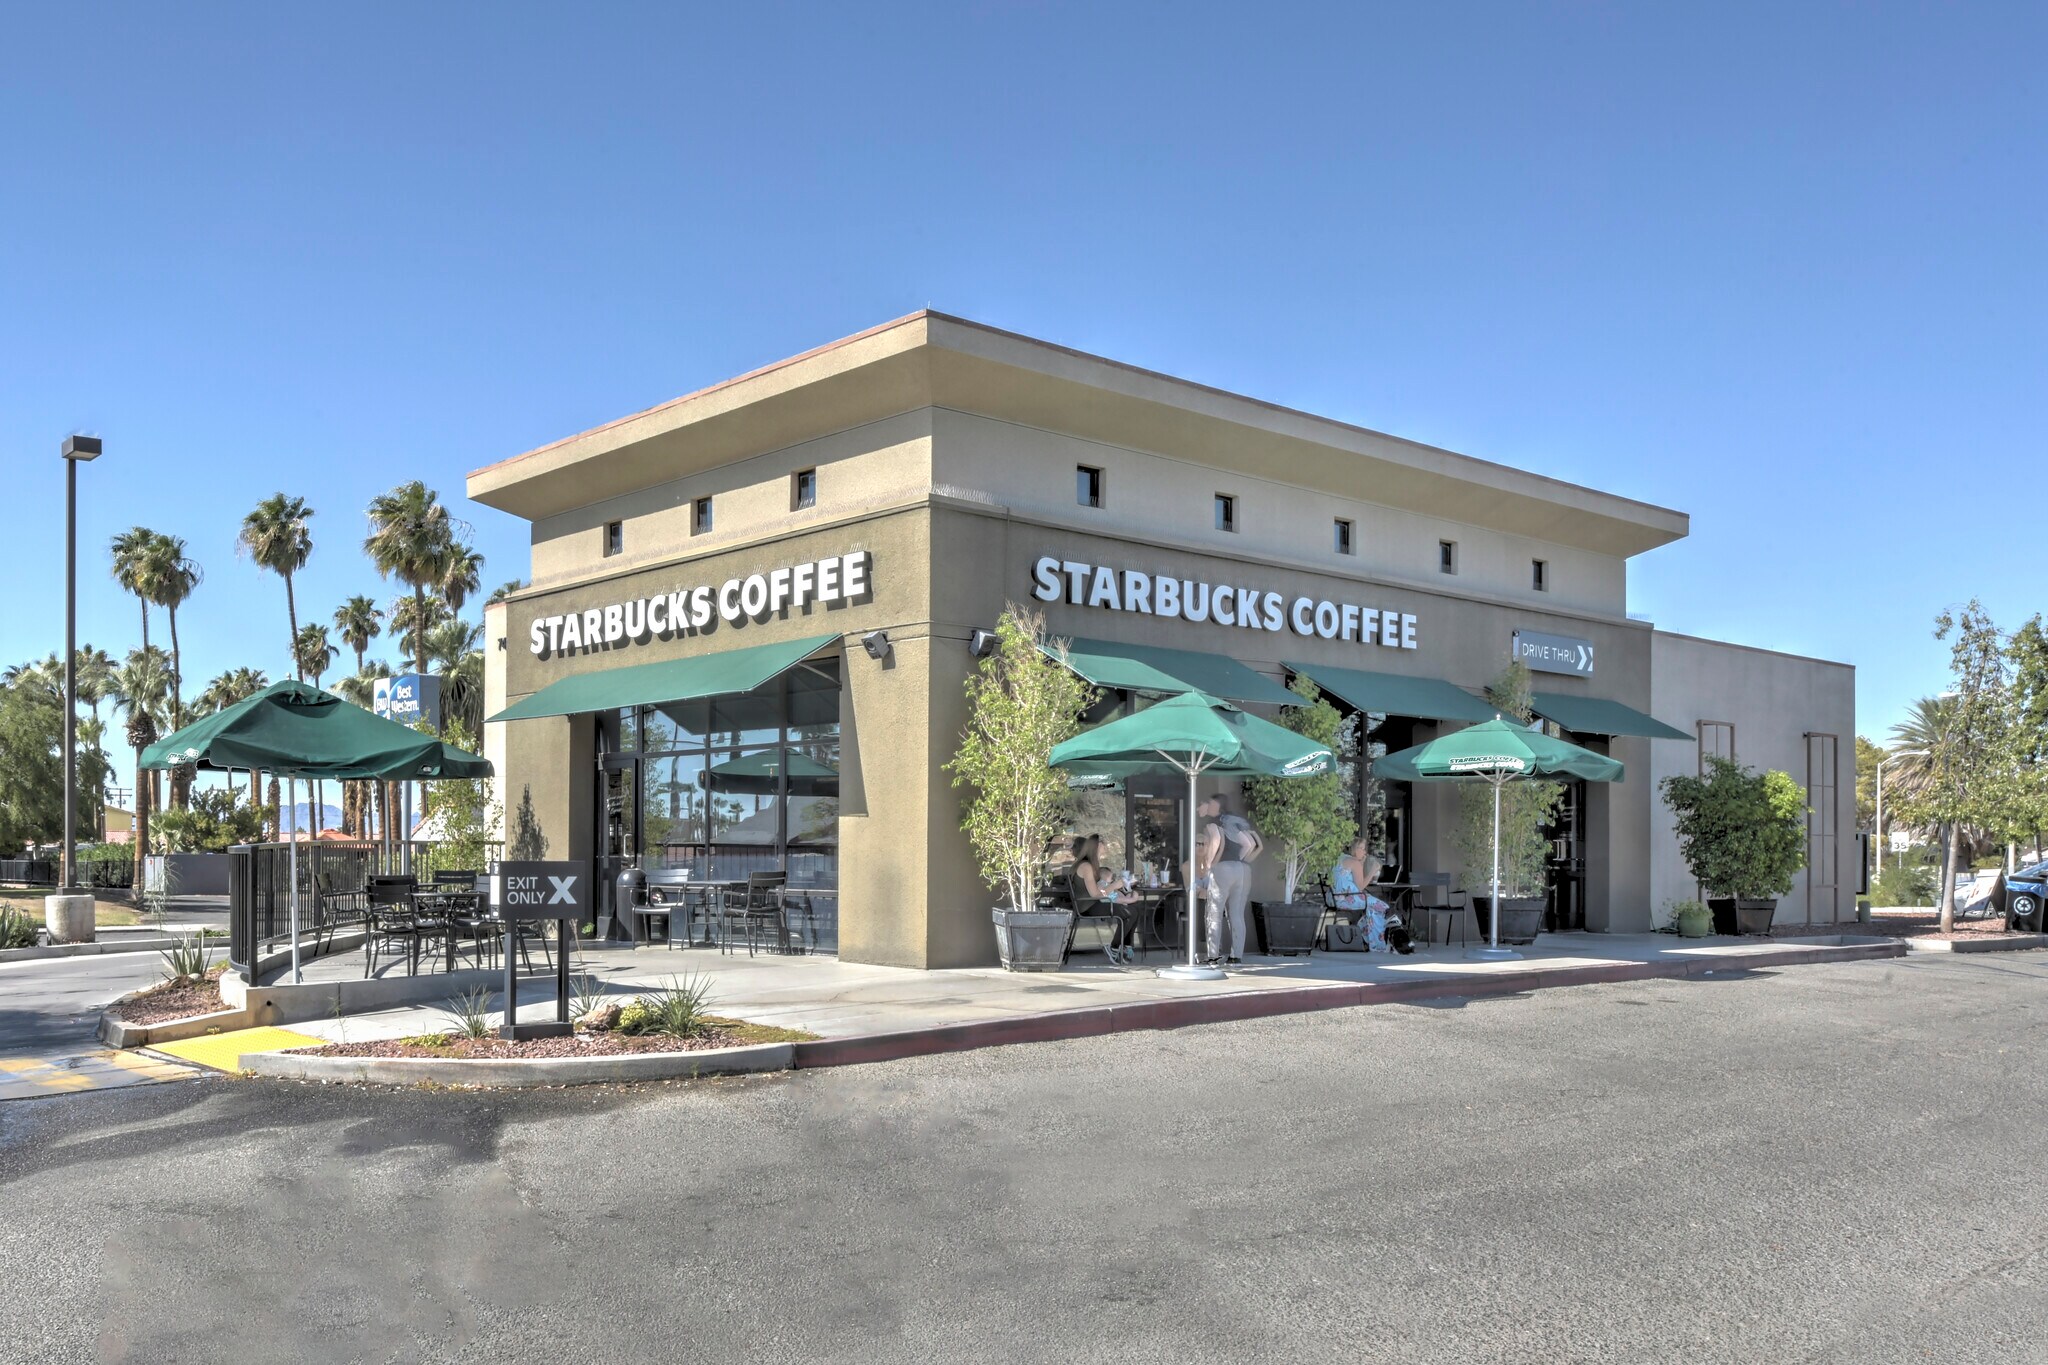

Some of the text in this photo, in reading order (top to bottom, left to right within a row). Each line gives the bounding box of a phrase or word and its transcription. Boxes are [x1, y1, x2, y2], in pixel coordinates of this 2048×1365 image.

[530, 551, 866, 654] STARBUCKS COFFEE
[1034, 557, 1417, 649] STARBUCKS COFFEE
[1522, 642, 1576, 663] DRIVE THRU
[397, 685, 412, 699] Best
[391, 699, 417, 713] Western
[1894, 842, 1907, 850] 35
[507, 876, 538, 890] EXIT
[507, 891, 546, 905] ONLY
